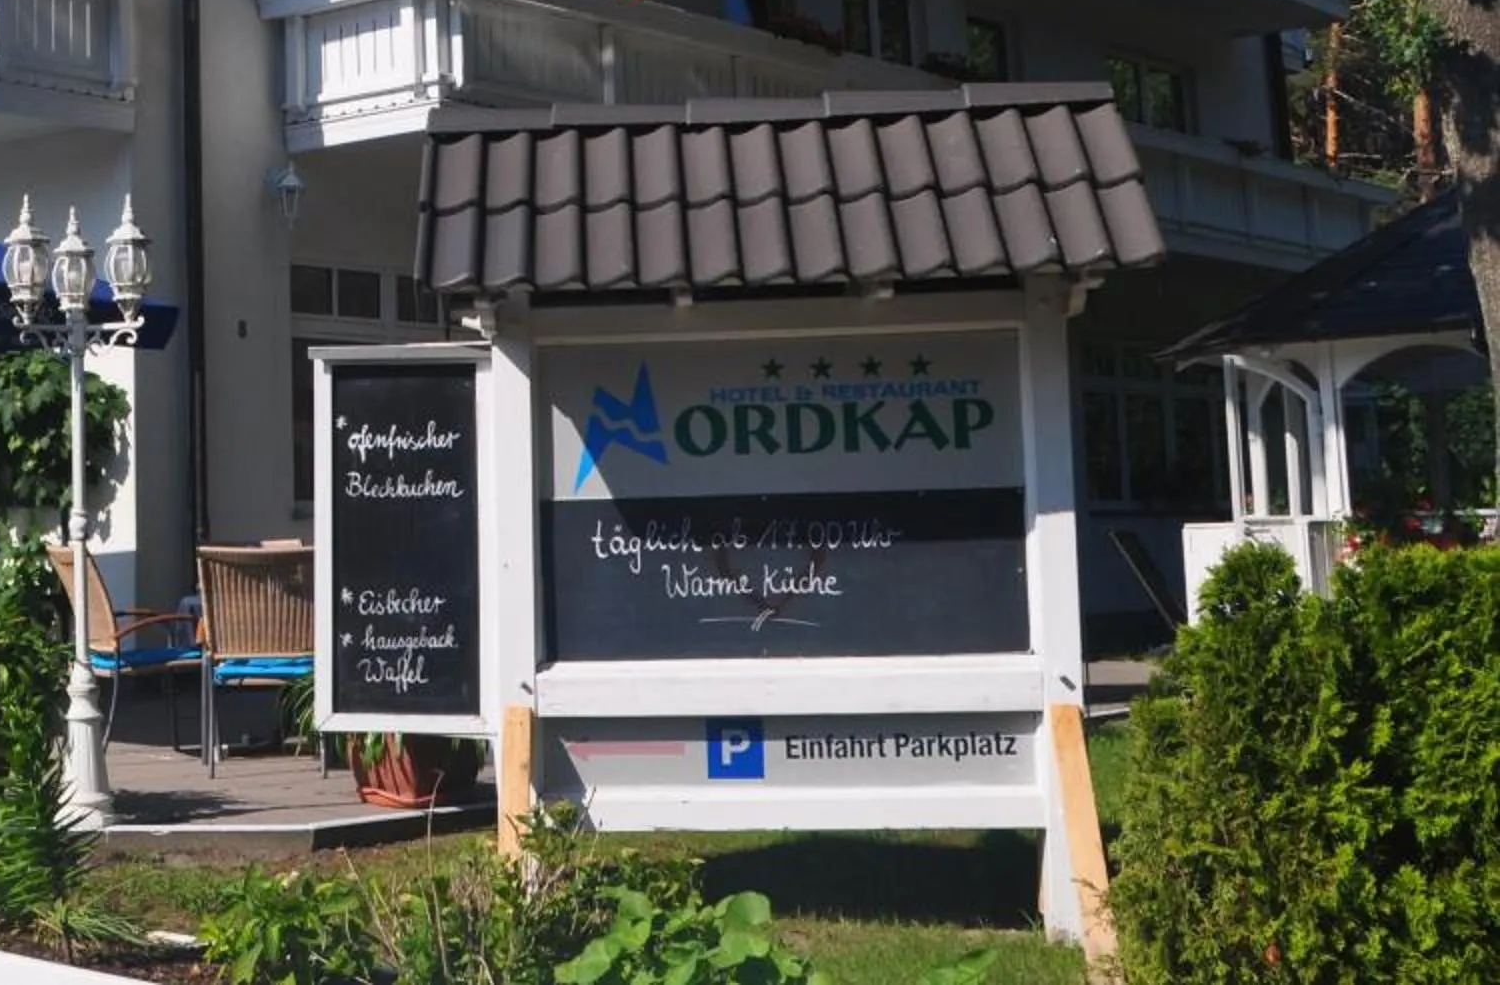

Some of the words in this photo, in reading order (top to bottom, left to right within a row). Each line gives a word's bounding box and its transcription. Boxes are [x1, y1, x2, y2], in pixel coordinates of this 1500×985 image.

[709, 385, 787, 404] HOTEL
[821, 379, 982, 400] RESTAURANT
[347, 420, 462, 464] ofenfrischer
[345, 468, 466, 499] Blechkuchen
[591, 519, 703, 575] täglich
[711, 518, 749, 550] ab
[756, 520, 843, 551] 17.00
[850, 519, 902, 550] Uhr
[660, 563, 753, 600] Warme
[762, 561, 844, 598] Küche
[358, 587, 447, 616] Eisbecher
[356, 655, 430, 694] Waffel
[720, 728, 751, 767] P
[784, 732, 887, 761] Einfahrt
[894, 728, 1018, 763] Parkplatz
